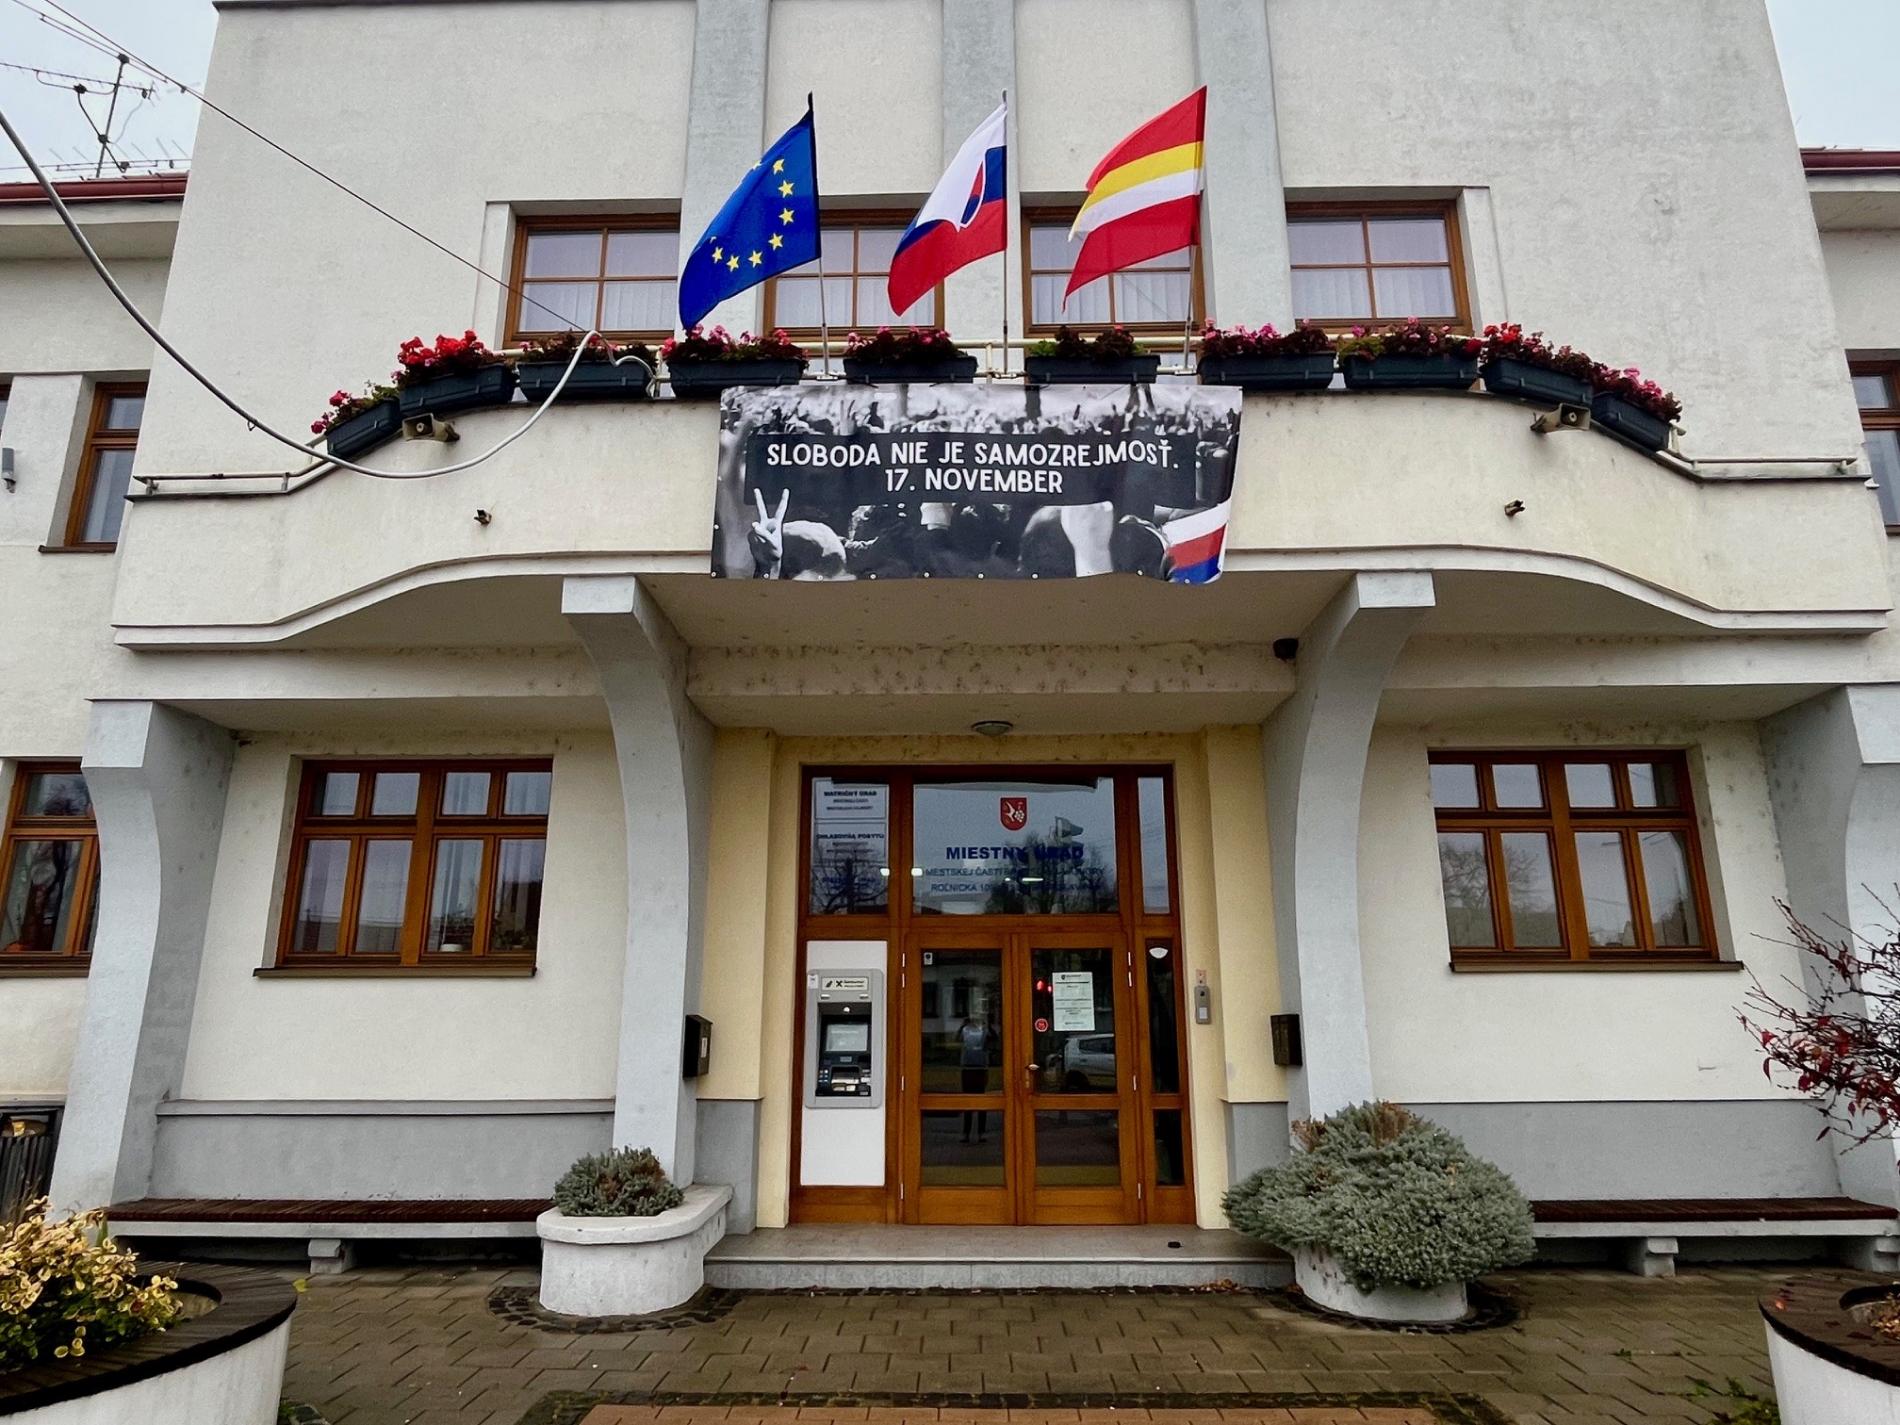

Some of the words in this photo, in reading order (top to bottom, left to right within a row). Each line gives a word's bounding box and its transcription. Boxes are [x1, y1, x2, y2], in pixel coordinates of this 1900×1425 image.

[767, 443, 881, 467] SLOBODA
[891, 442, 928, 464] NIE
[938, 442, 965, 464] JE
[974, 439, 1179, 468] SAMOZREJMOSŤ.
[885, 469, 915, 491] 17.
[925, 468, 1063, 493] NOVEMBER
